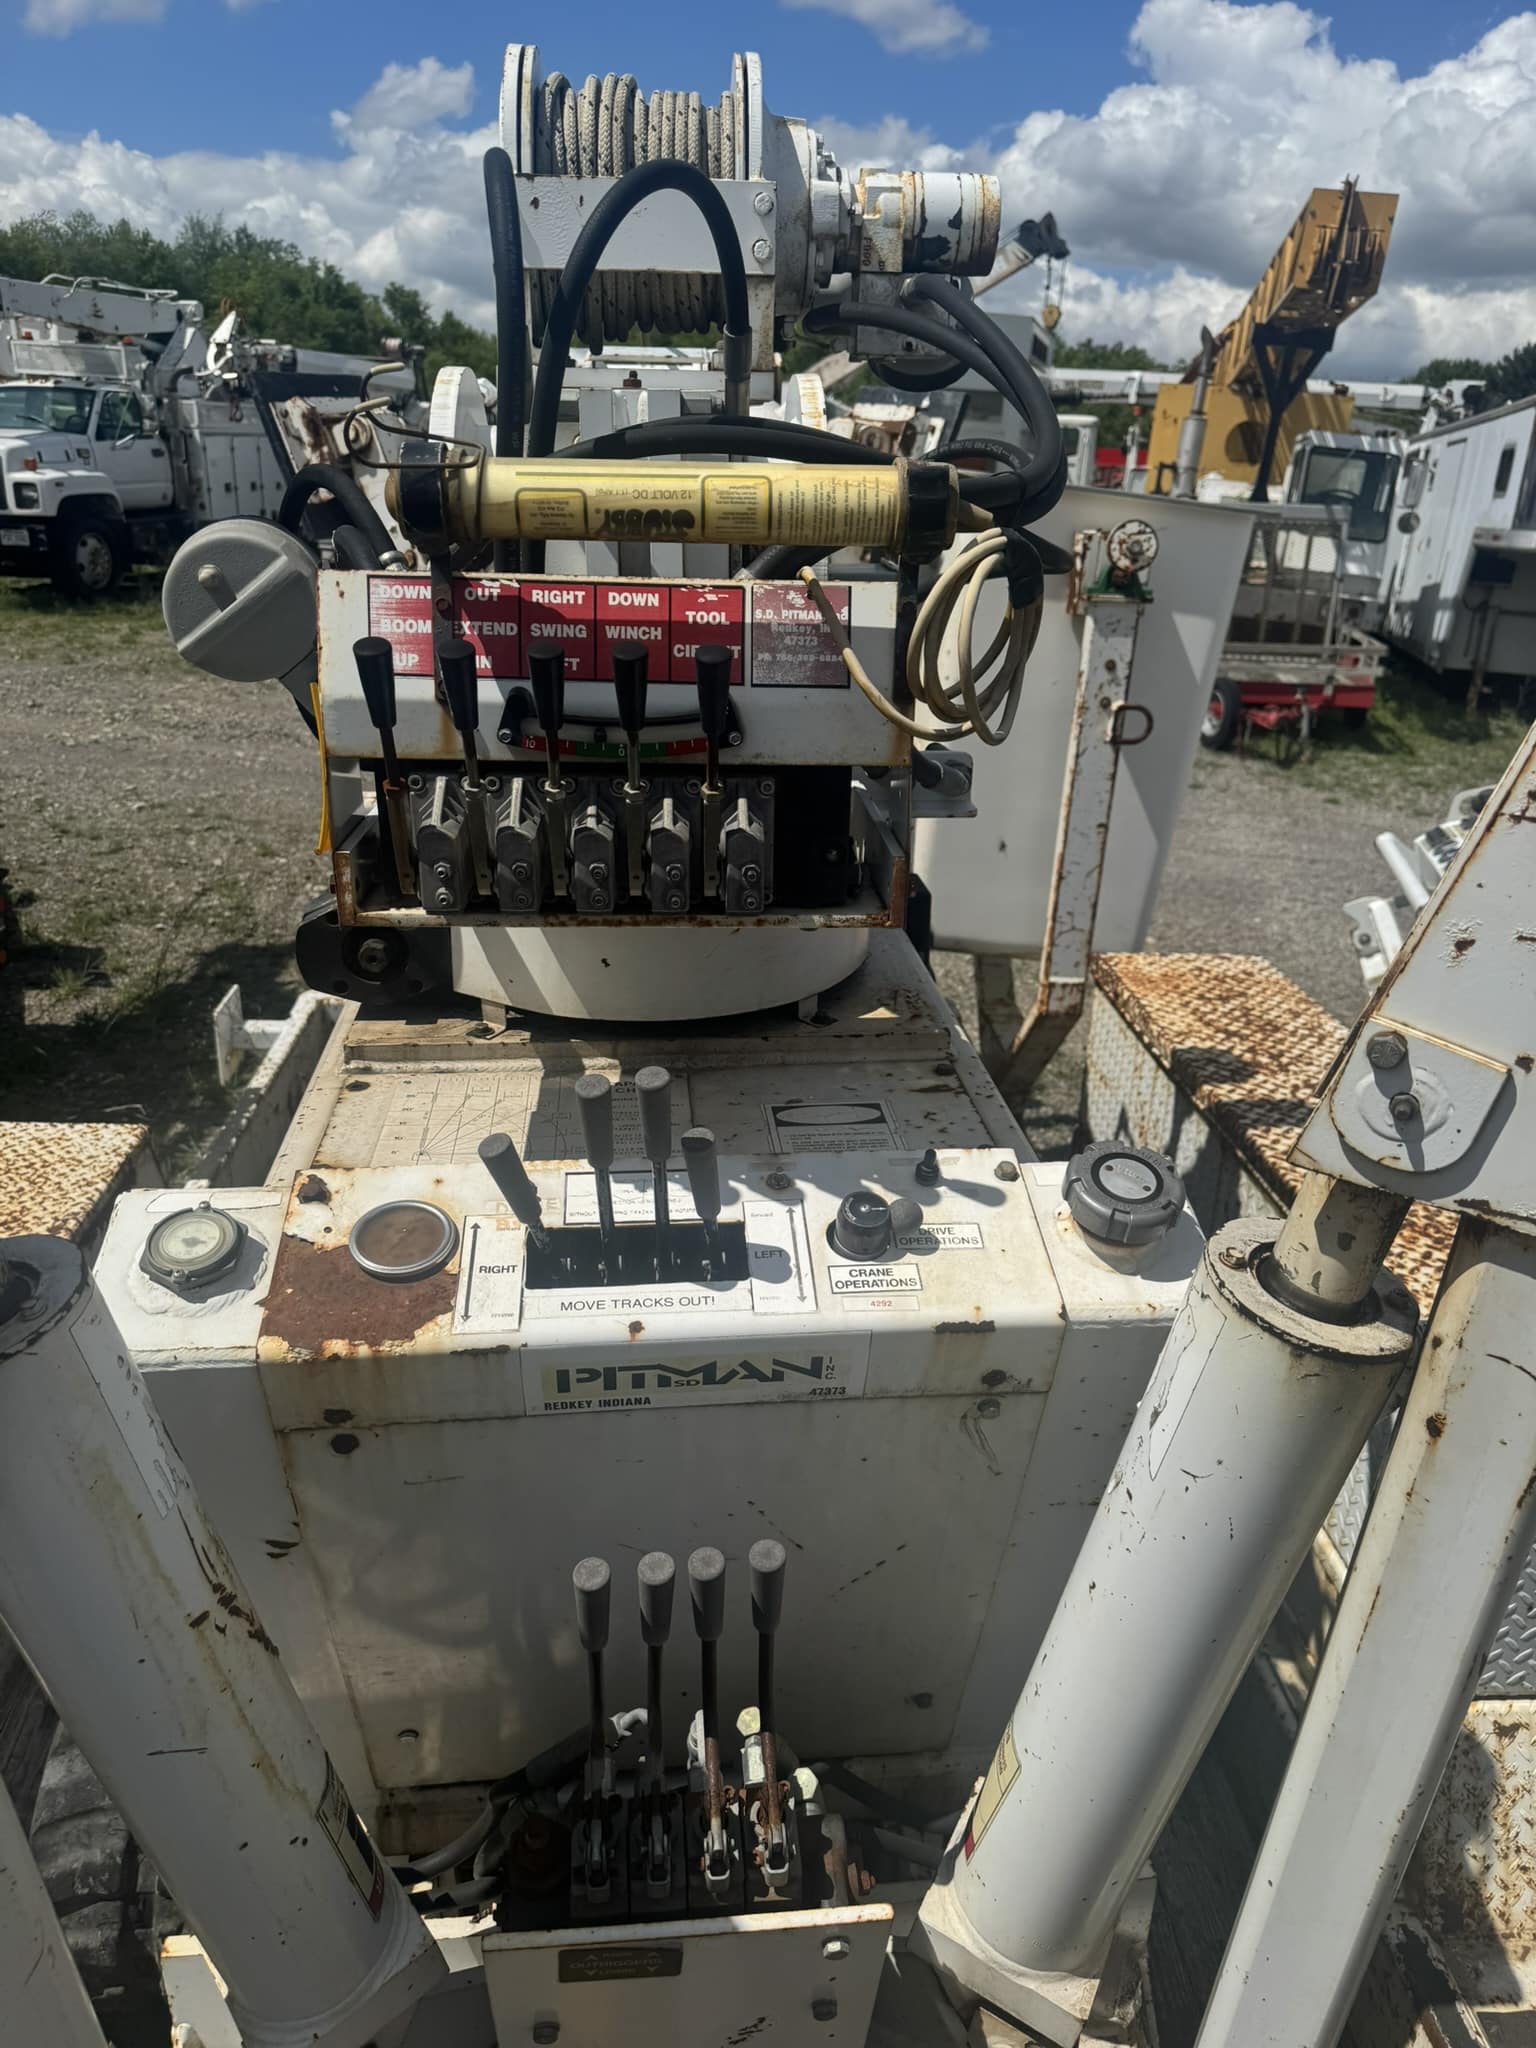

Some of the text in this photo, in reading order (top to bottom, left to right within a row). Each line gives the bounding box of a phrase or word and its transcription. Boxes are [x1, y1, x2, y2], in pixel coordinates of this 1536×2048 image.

[632, 489, 649, 500] DC
[652, 490, 678, 500] VOLT
[380, 585, 432, 599] DOWN
[465, 587, 501, 602] OUT
[531, 589, 586, 604] RIGHT
[608, 592, 659, 607] DOWN
[685, 611, 730, 625] TOOL
[380, 619, 432, 633] BOOM
[530, 623, 587, 638] SWING
[605, 625, 662, 640] WINCH
[784, 636, 818, 646] 47373
[393, 653, 419, 666] UP
[475, 655, 493, 669] IN
[918, 1227, 955, 1236] DRIVE
[899, 1236, 979, 1247] OPERATIONS
[754, 1250, 784, 1260] LEFT
[479, 1265, 518, 1274] RIGHT
[849, 1268, 895, 1278] CRANE
[835, 1278, 918, 1290] OPERATIONS
[560, 1296, 716, 1311] MOVE TRACKS OUT!
[556, 1356, 824, 1394] PITMAN
[674, 1378, 701, 1388] SD
[809, 1386, 847, 1397] 47373
[544, 1397, 652, 1411] REDKEY INDIANA
